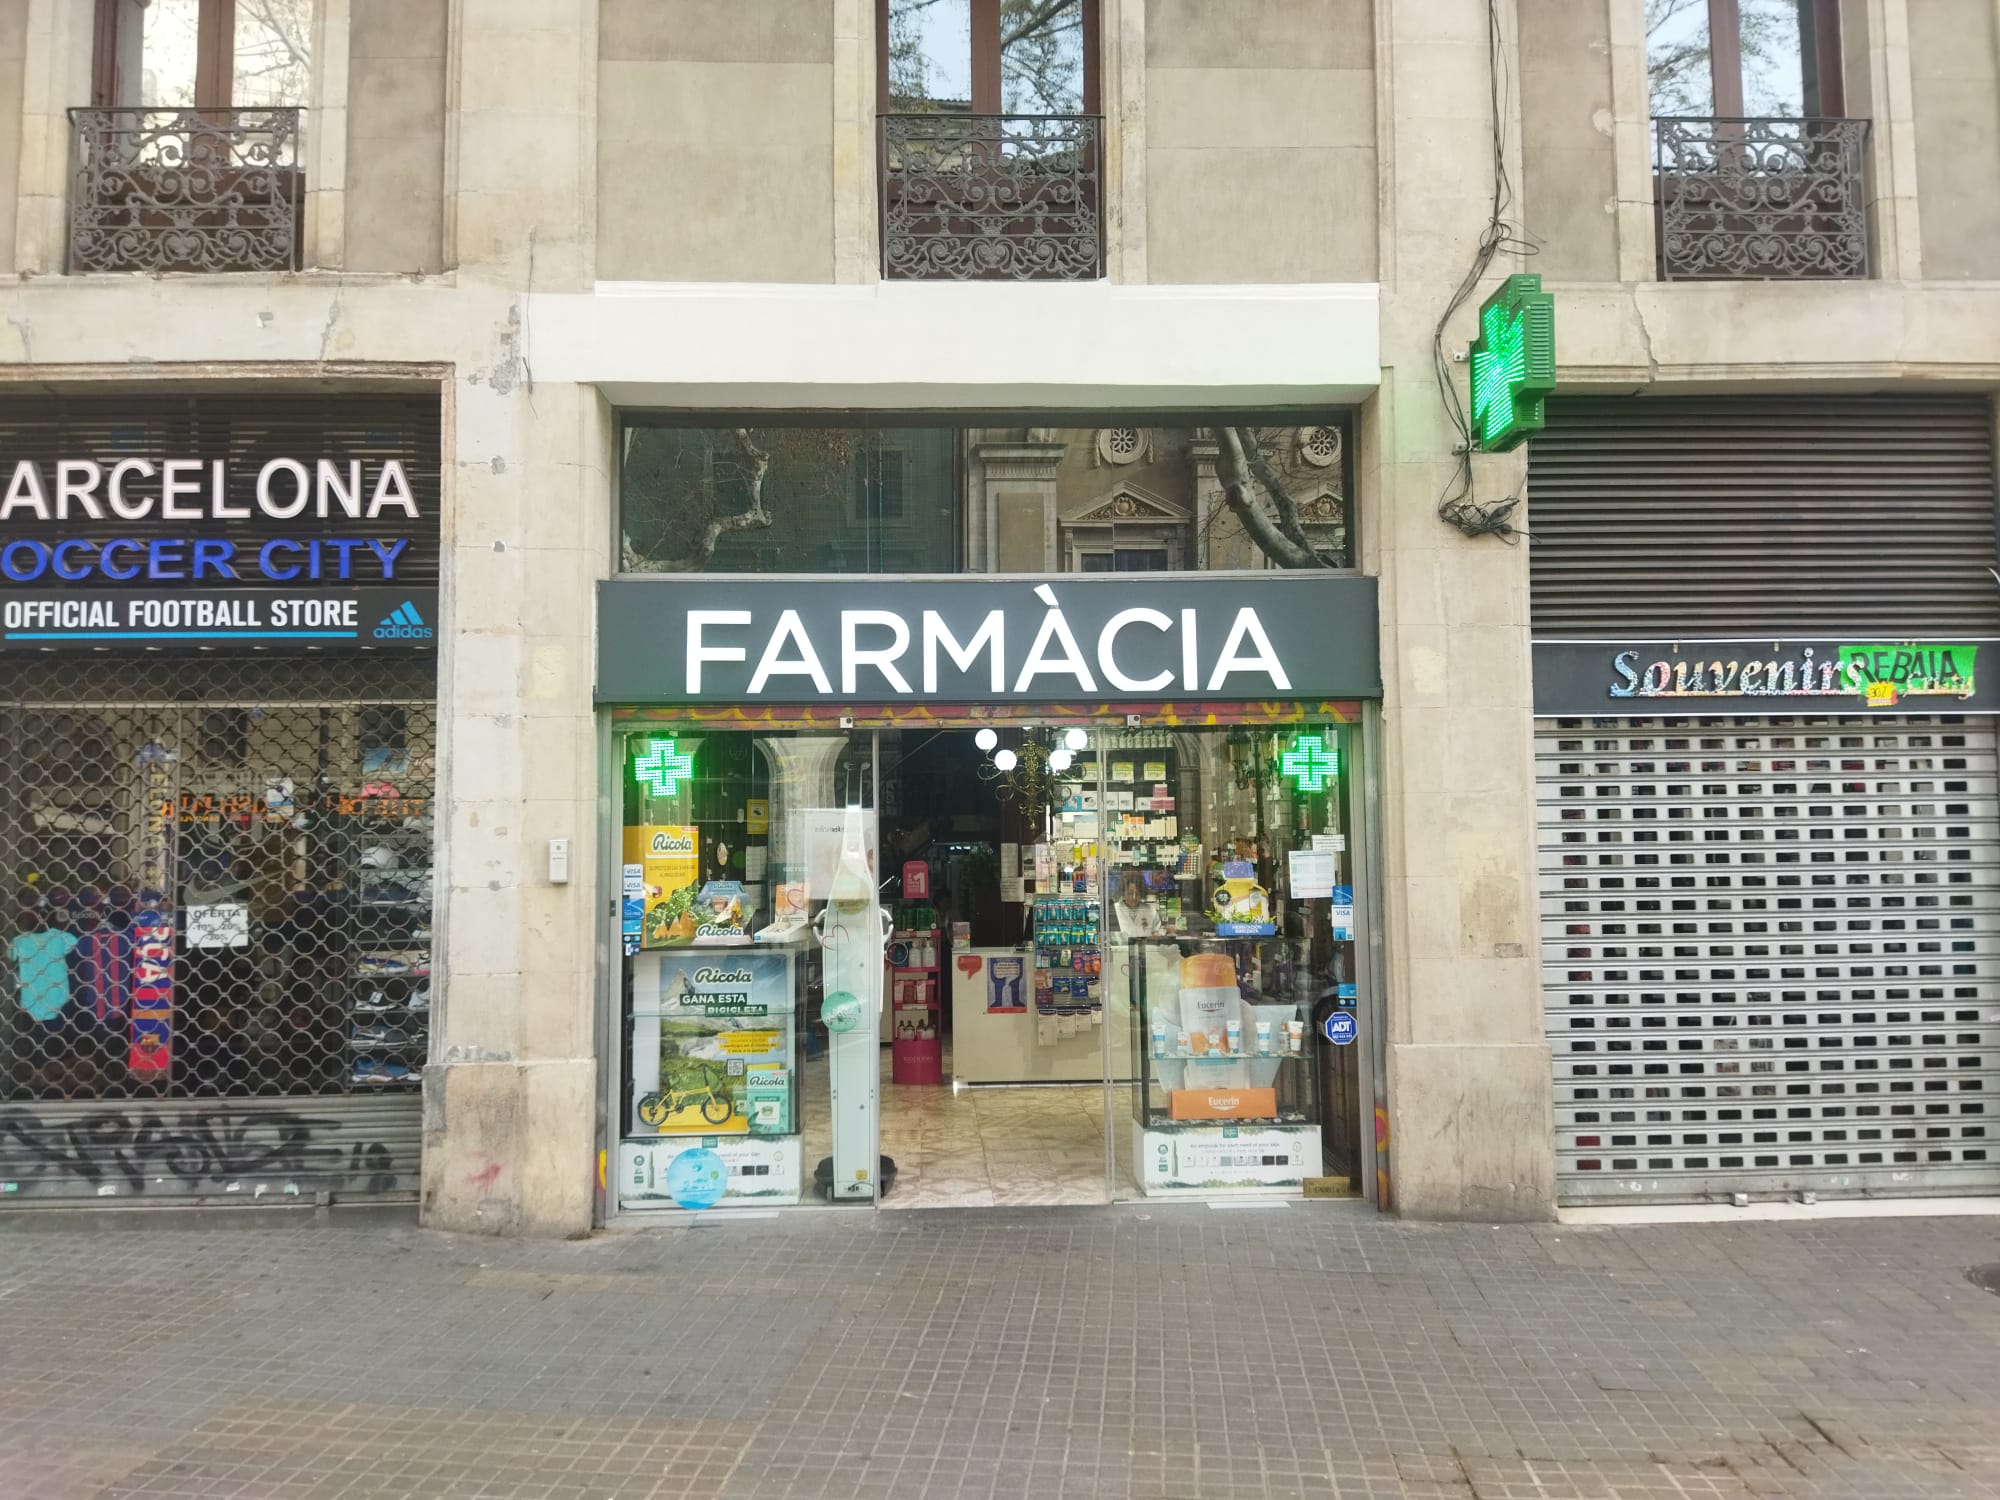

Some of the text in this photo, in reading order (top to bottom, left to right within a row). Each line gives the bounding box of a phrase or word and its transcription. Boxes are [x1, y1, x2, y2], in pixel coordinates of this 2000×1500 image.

[258, 538, 408, 580] CITY
[4, 600, 358, 628] OFFICIAL FOOTBALL STORE
[373, 624, 432, 639] adidas
[684, 583, 1293, 696] FARMÀCIA
[1610, 647, 1866, 697] Souvenirs
[652, 832, 693, 851] Ricola
[696, 924, 744, 937] Ricola
[694, 967, 752, 984] Ricola
[682, 994, 746, 1004] GANA ESTA
[1332, 1020, 1352, 1033] ADT
[749, 1076, 785, 1086] Ricola
[1208, 1096, 1240, 1106] Eucerin
